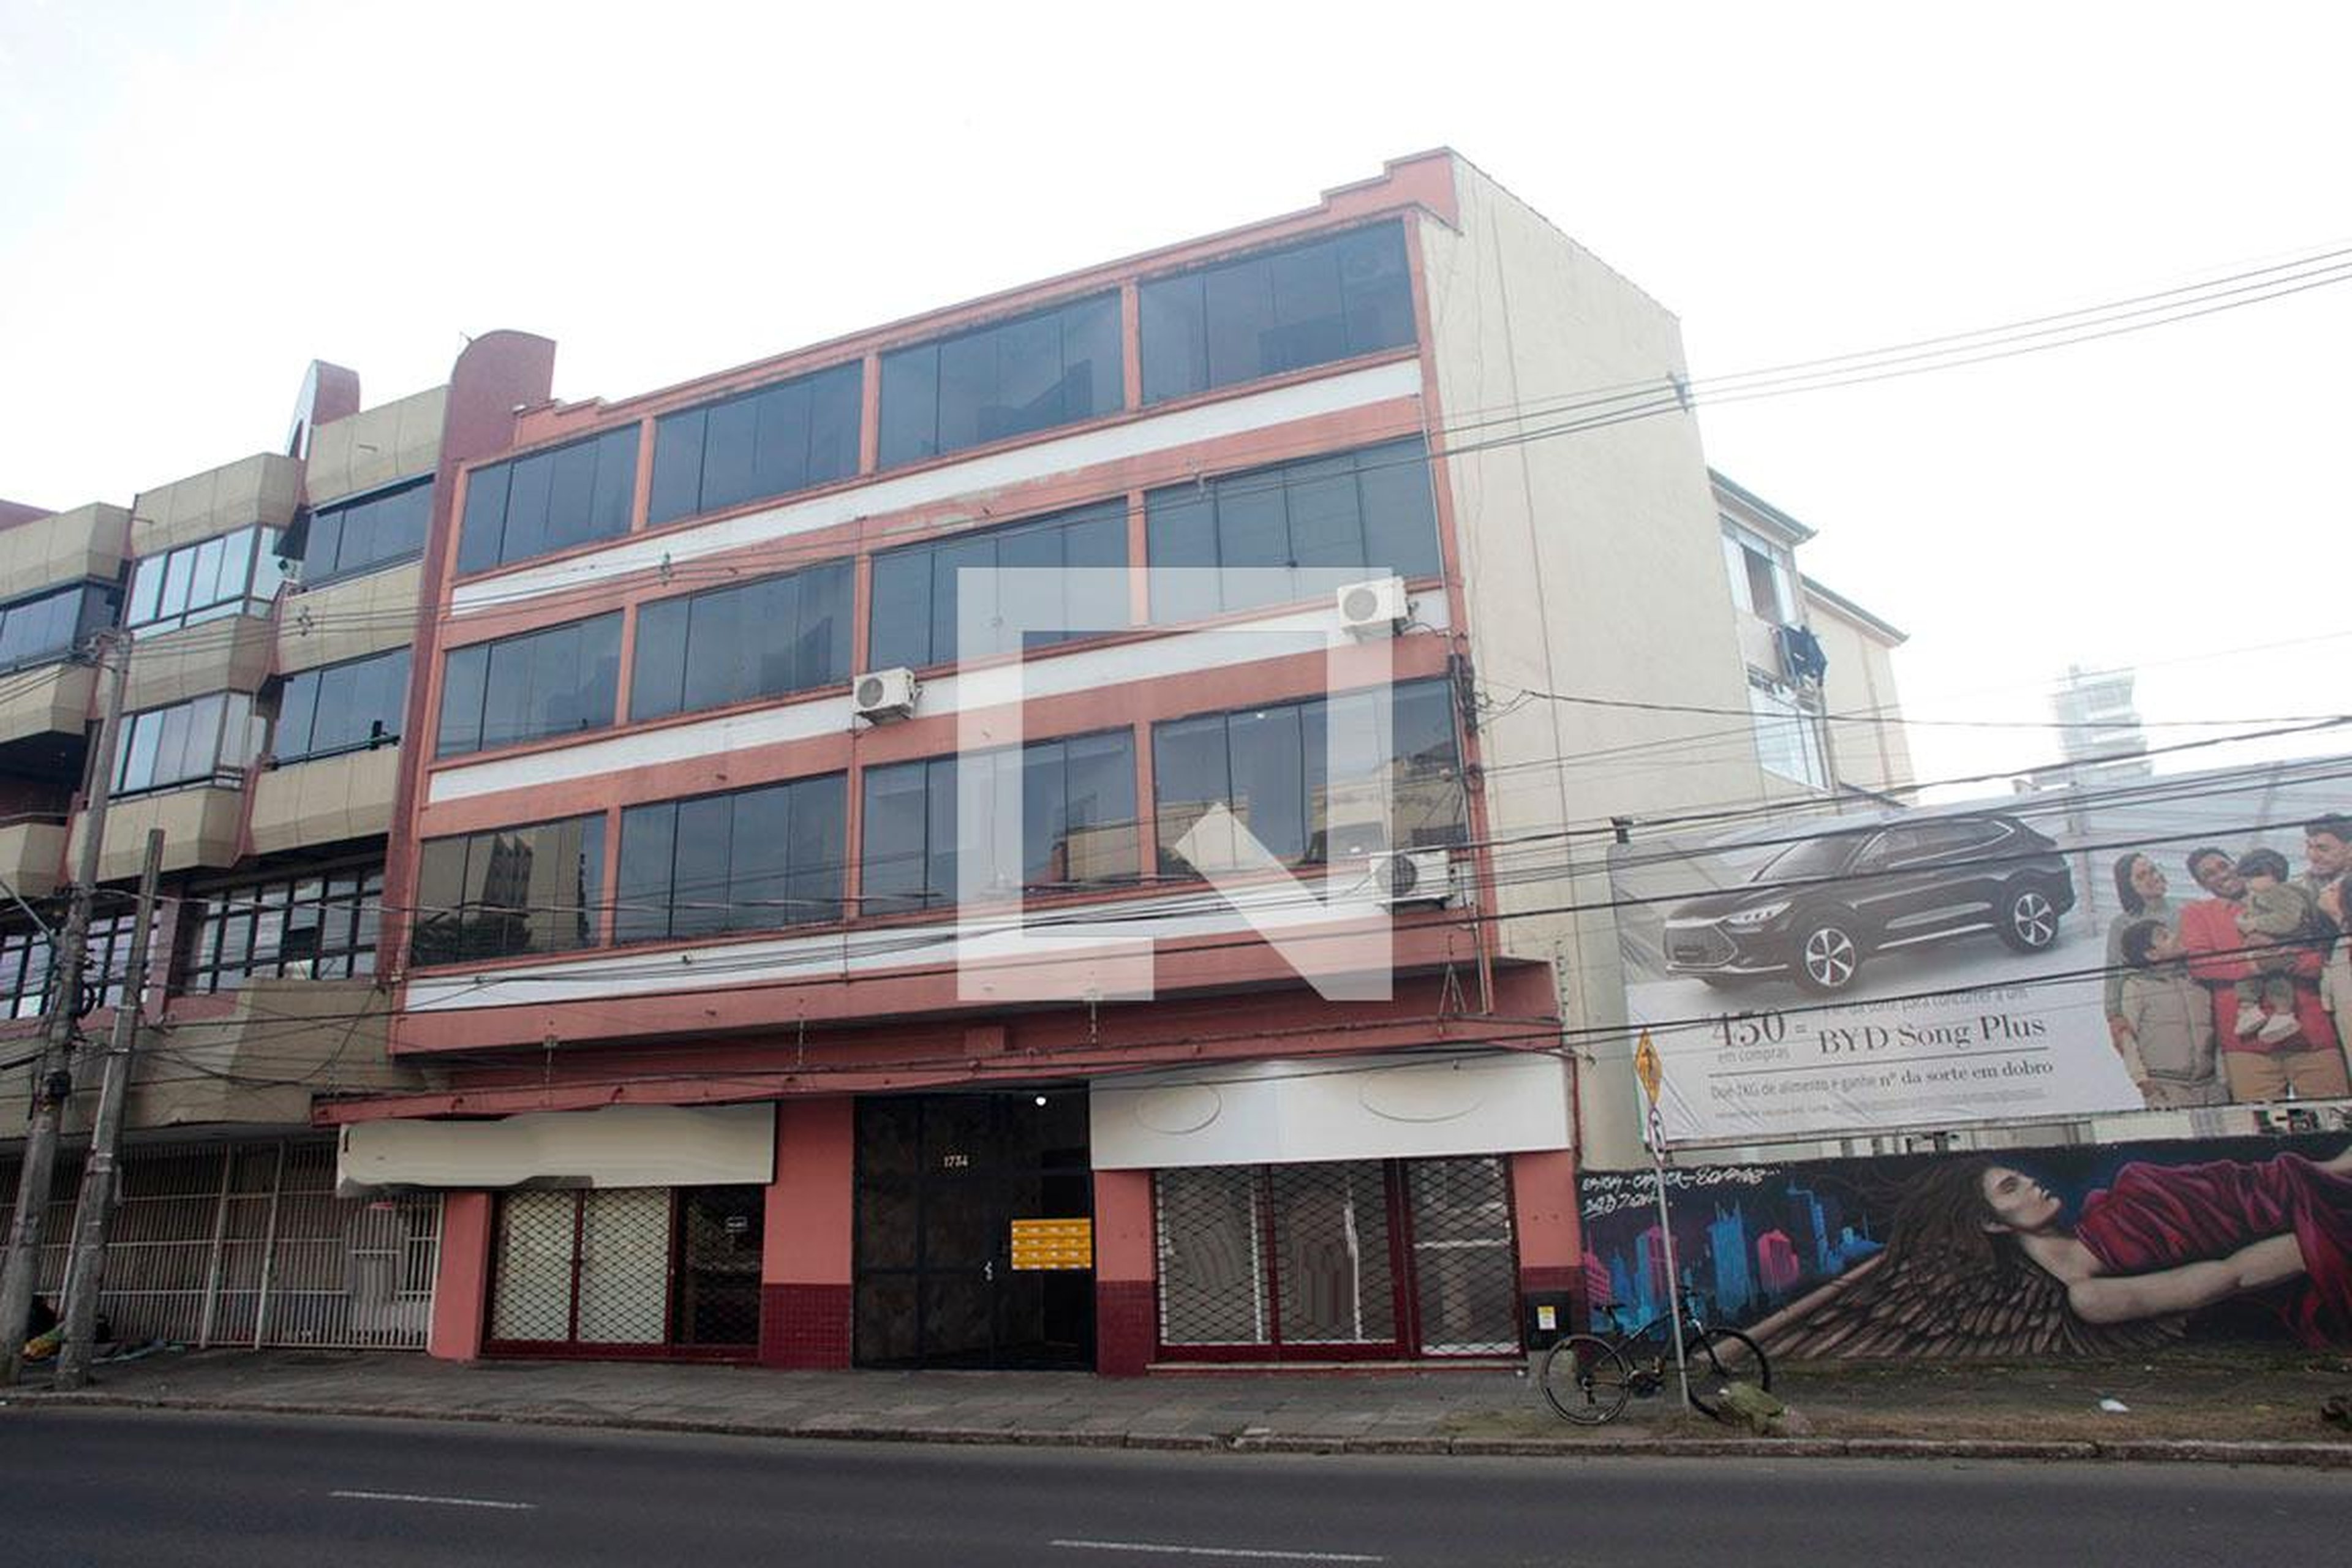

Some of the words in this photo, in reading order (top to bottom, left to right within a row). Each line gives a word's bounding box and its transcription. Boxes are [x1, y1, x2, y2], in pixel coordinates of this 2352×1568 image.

[1819, 1026, 1888, 1054] BYD
[1899, 1023, 1970, 1050] Song
[1981, 1014, 2046, 1041] Plus
[1717, 1051, 1736, 1064] em
[1738, 1048, 1790, 1063] compras
[1901, 1069, 1922, 1084] da
[1926, 1068, 1968, 1082] sorte
[1972, 1066, 1999, 1079] em
[2002, 1060, 2054, 1076] dobro
